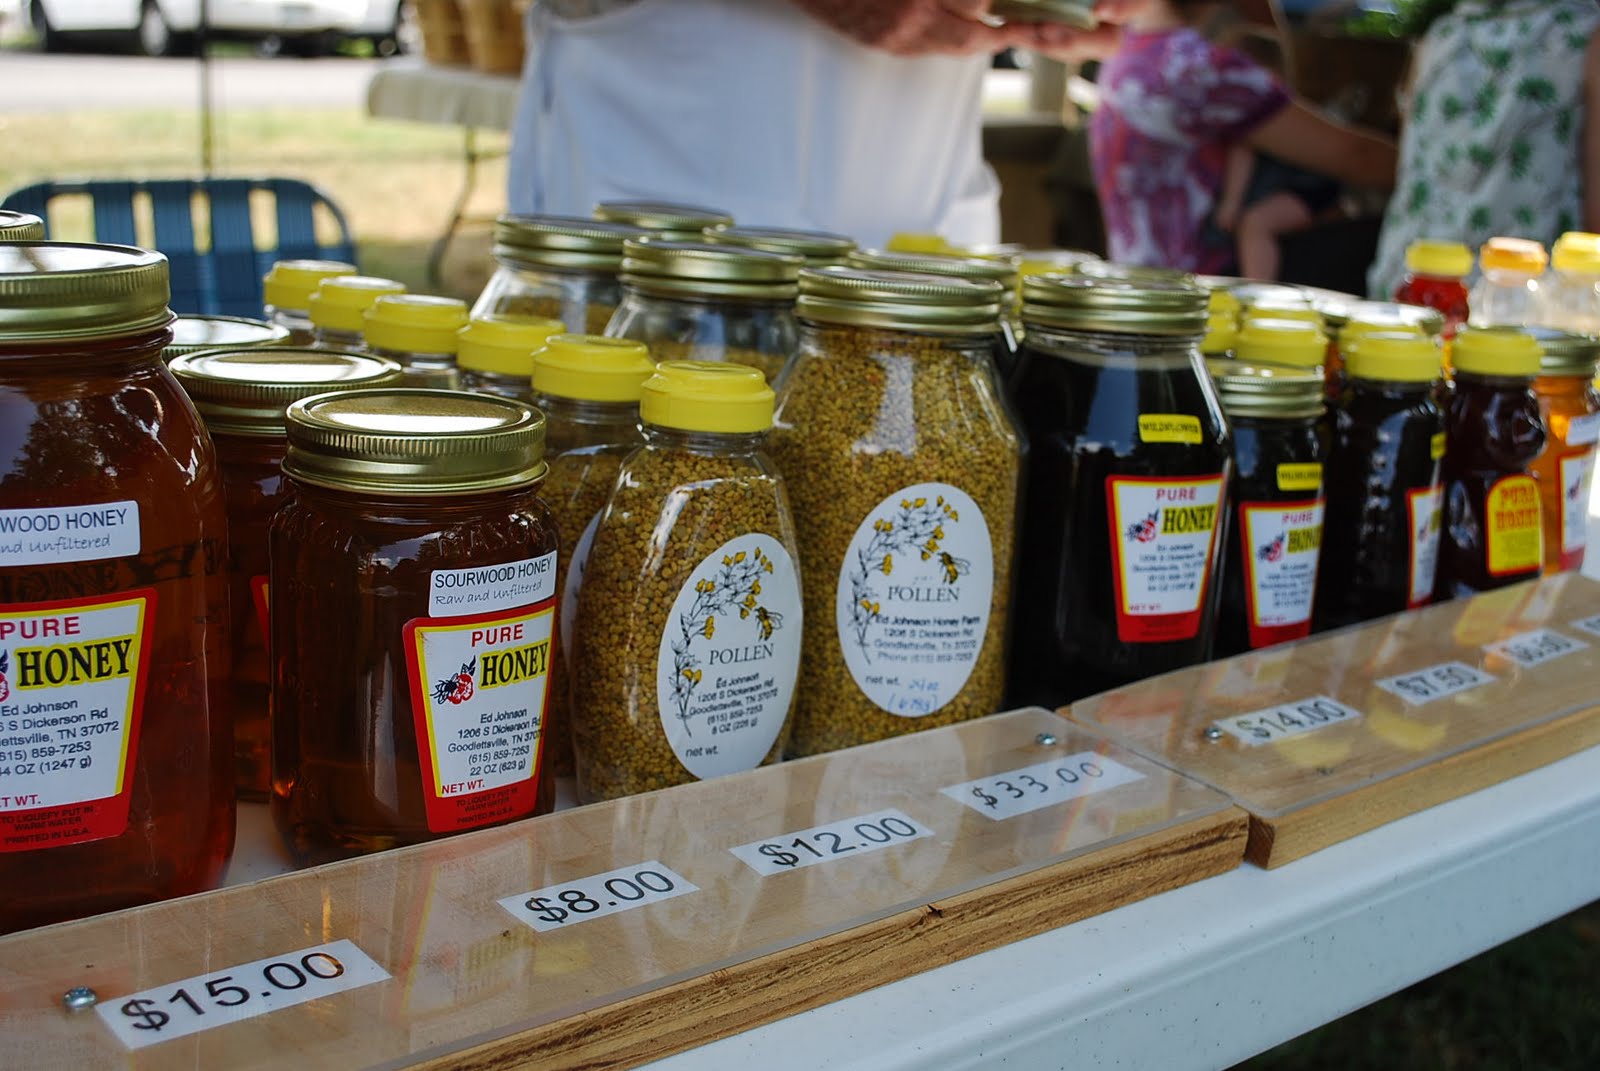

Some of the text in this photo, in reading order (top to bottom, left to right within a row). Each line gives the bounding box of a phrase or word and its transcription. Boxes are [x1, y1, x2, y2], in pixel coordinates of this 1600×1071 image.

[1156, 487, 1197, 500] PURE
[66, 508, 127, 530] HONEY
[1163, 504, 1216, 533] HONEY
[29, 533, 111, 555] Unfiltered
[435, 557, 552, 588] SOURWOOD HONEY
[435, 579, 543, 605] Raw and Unfiltered
[888, 586, 960, 602] POLLEN
[0, 616, 80, 640] PURE
[875, 614, 889, 625] Ed
[892, 616, 931, 626] Johnson
[933, 617, 959, 627] Honey
[471, 623, 524, 648] PURE
[17, 638, 132, 687] HONEY
[481, 641, 549, 687] HONEY
[709, 643, 774, 665] POLLEN
[698, 676, 774, 703] 1206 S Dickerson Rd
[716, 671, 760, 689] Ed Johnson
[1, 699, 78, 717] Ed Johnson
[480, 708, 527, 724] Ed Johnson
[9, 720, 18, 731] S
[23, 713, 86, 730] Dickerson
[91, 707, 109, 720] Rd
[1236, 700, 1346, 739] $14.00
[57, 727, 77, 740] TN
[81, 720, 119, 737] 37072
[458, 729, 480, 740] 1206
[483, 726, 490, 737] S
[492, 720, 530, 736] Dickerson
[32, 740, 92, 758] 859-7253
[448, 736, 509, 753] Goodlettsville,
[512, 733, 523, 744] TN
[685, 746, 703, 758] net
[15, 763, 36, 775] OZ
[40, 757, 76, 775] (1247
[80, 754, 92, 769] g)
[468, 745, 530, 766] (615) 859-7253
[470, 757, 526, 776] 22 OZ (623 g)
[441, 778, 485, 794] NET WT.
[15, 794, 41, 806] WT.
[758, 817, 917, 867] $12.00
[525, 870, 675, 924] $8.00
[121, 952, 345, 1031] $15.00
